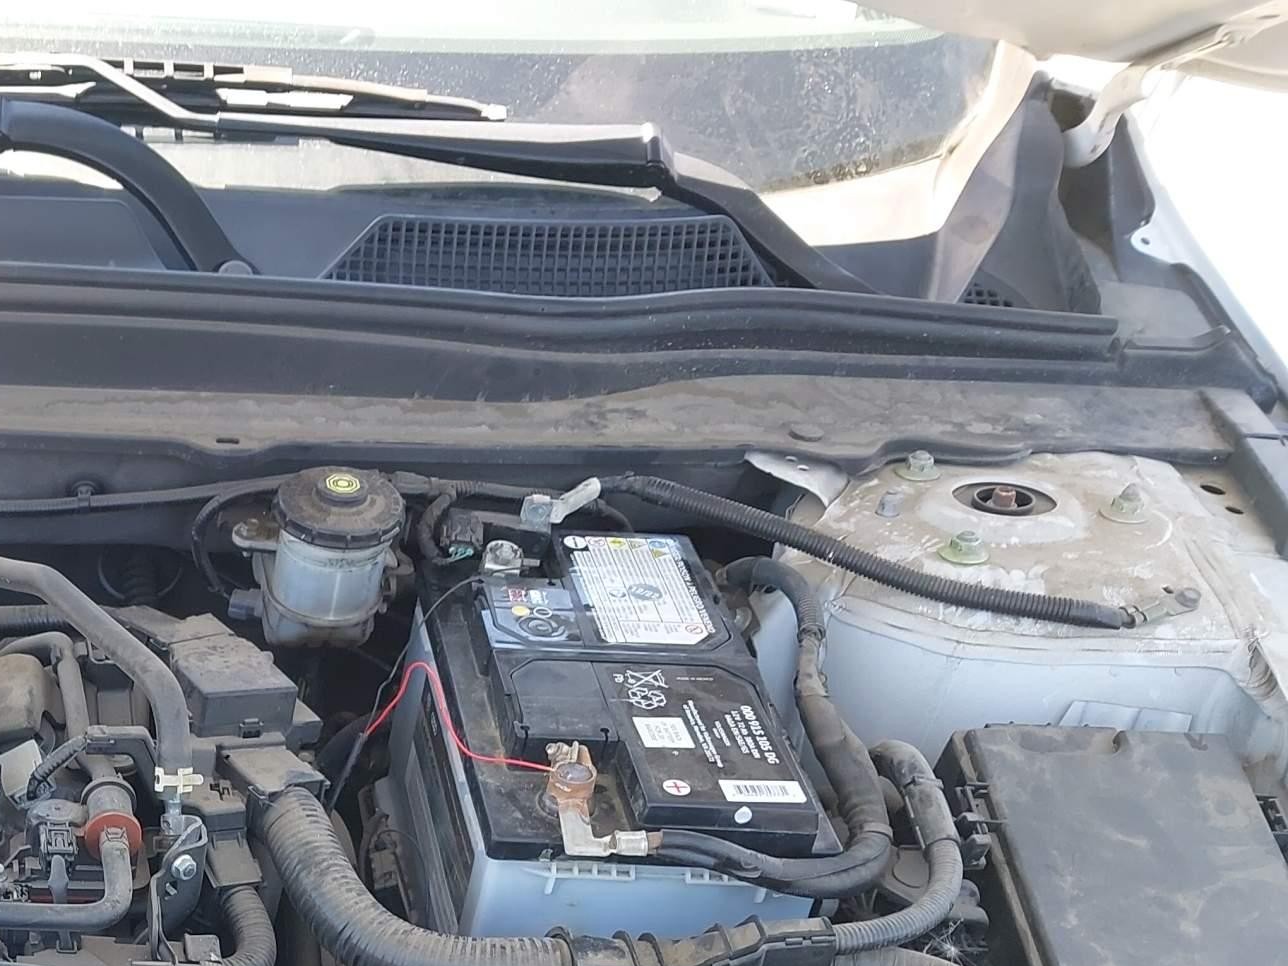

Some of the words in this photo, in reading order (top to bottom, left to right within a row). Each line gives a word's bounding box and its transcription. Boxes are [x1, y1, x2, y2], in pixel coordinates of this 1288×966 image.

[748, 720, 765, 736] 915
[756, 736, 773, 751] 105
[764, 751, 780, 764] DG
